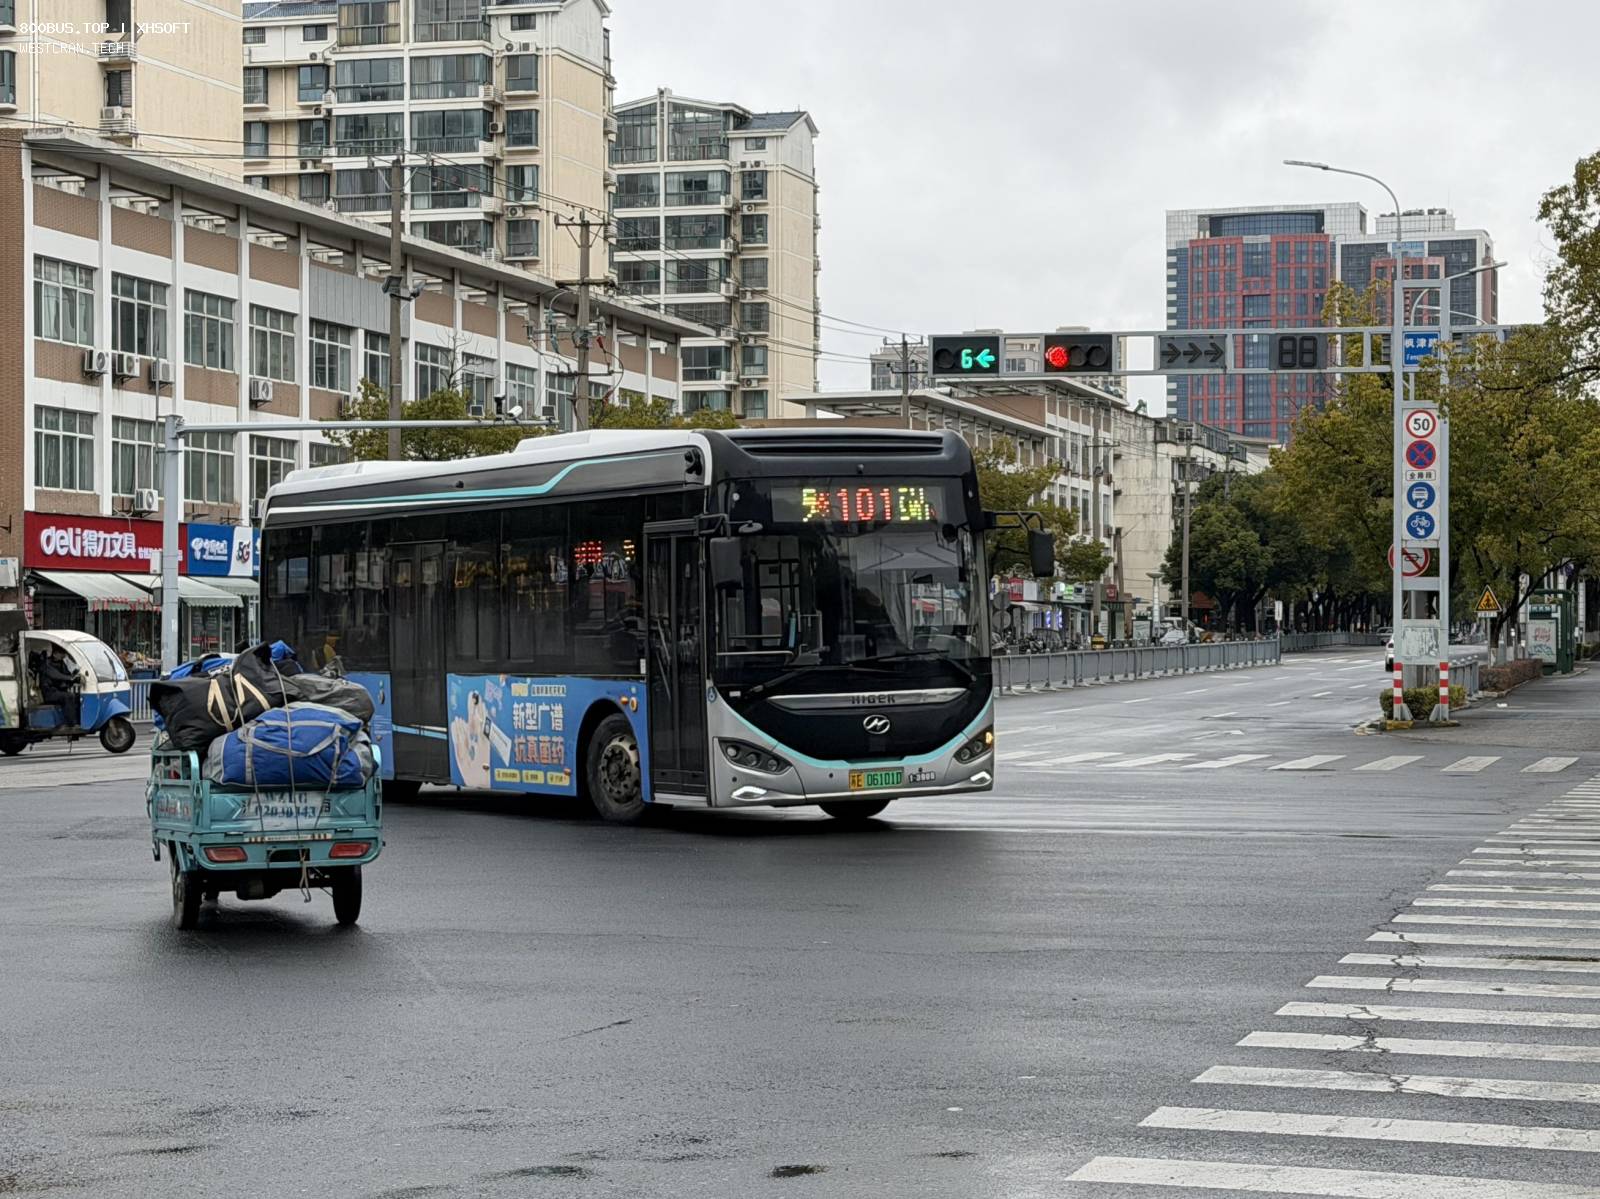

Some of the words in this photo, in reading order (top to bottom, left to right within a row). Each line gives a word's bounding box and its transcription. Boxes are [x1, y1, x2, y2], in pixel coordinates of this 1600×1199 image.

[961, 348, 973, 369] 6
[1413, 418, 1430, 431] 50
[836, 488, 891, 521] 101
[40, 526, 82, 557] deli
[82, 529, 136, 559] 得力文具
[851, 694, 896, 704] HIGER
[512, 702, 564, 731] 新型广谱
[513, 735, 565, 765] 抗真菌药
